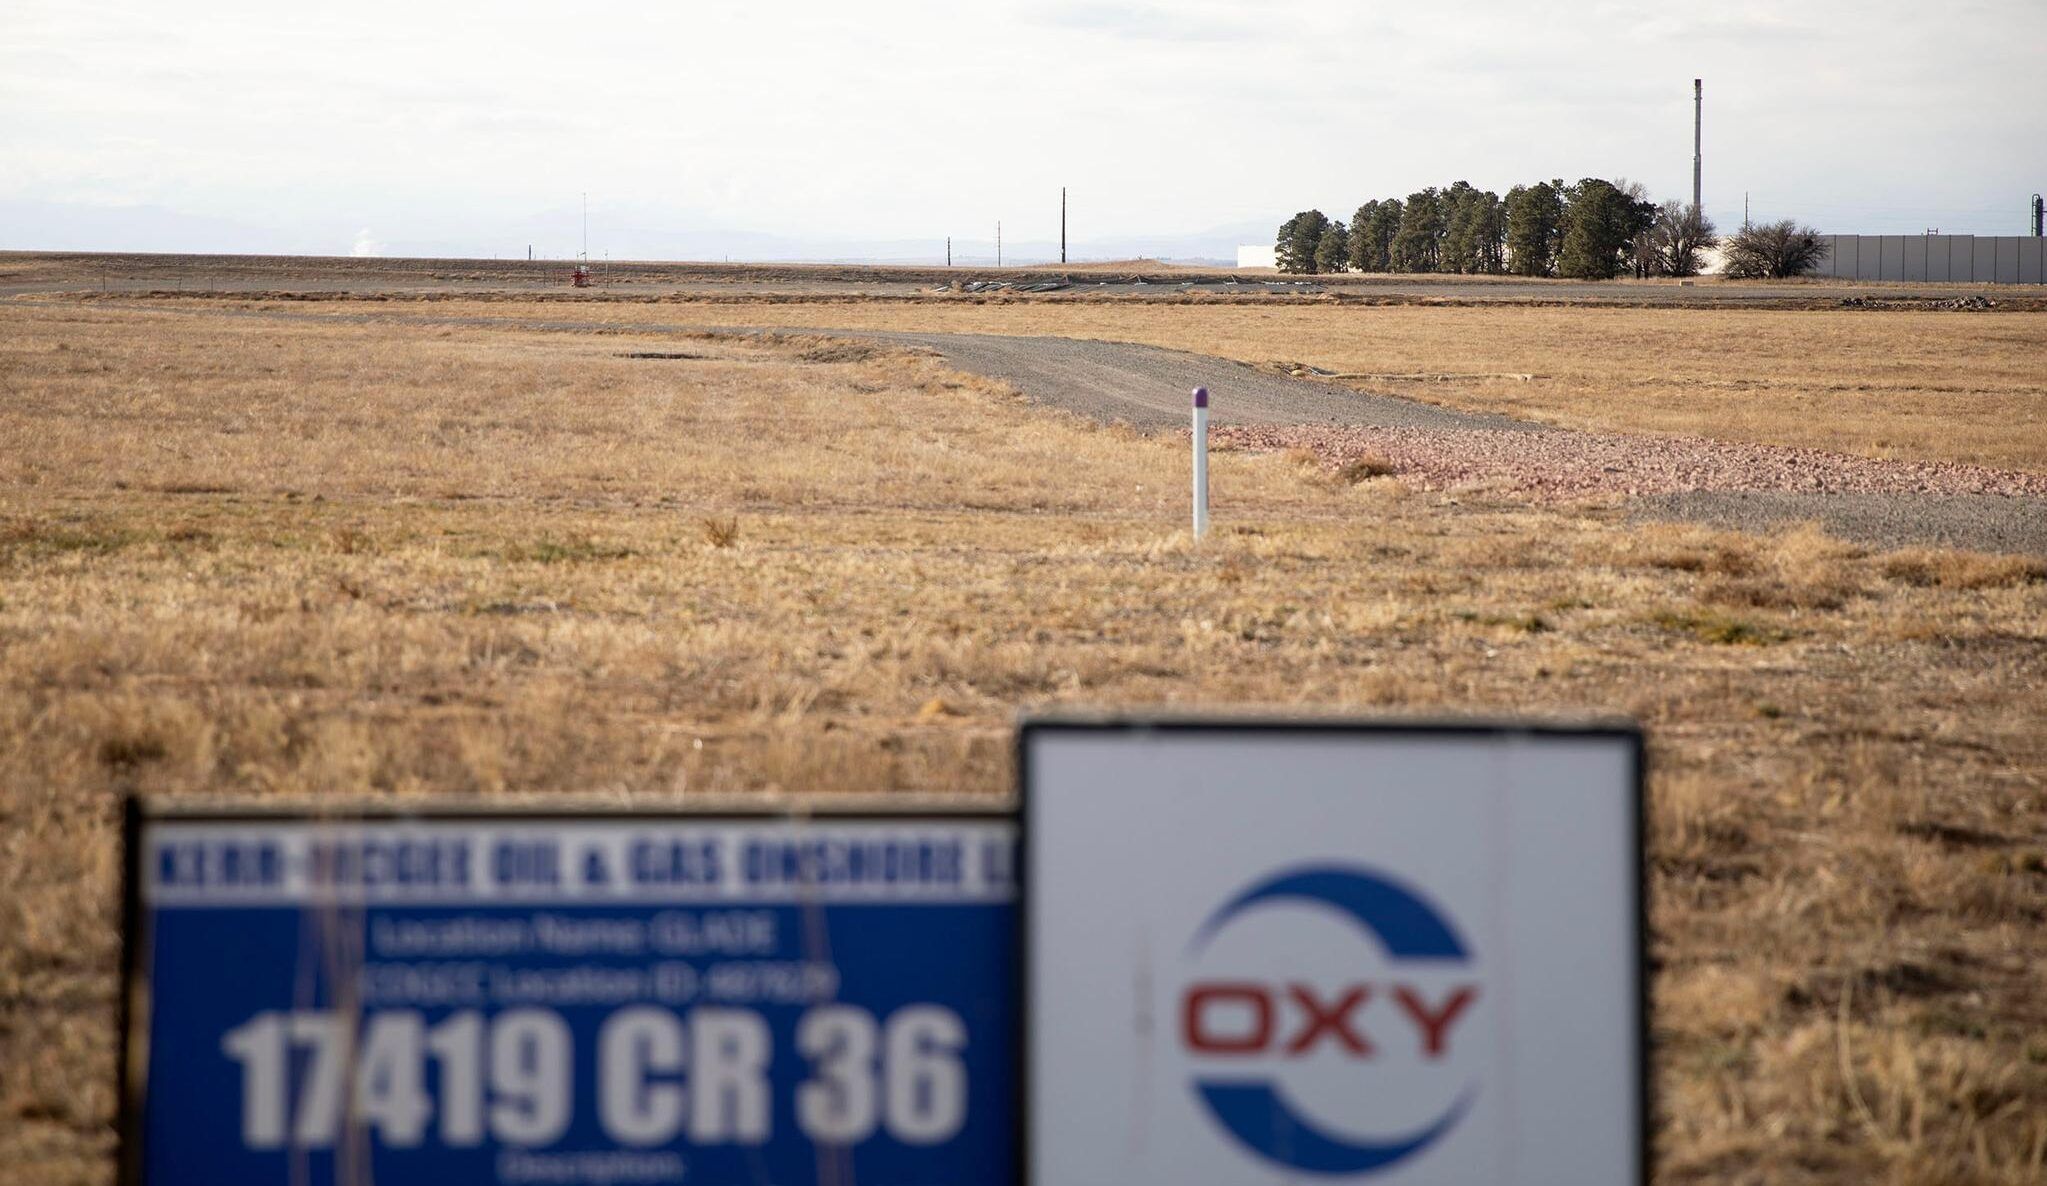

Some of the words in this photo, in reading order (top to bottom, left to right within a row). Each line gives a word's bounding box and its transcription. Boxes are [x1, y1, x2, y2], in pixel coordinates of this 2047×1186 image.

[489, 837, 566, 889] OIL
[578, 844, 613, 889] &
[627, 837, 724, 889] GAS
[1182, 983, 1478, 1059] OXY
[223, 1010, 573, 1147] 17419
[600, 1006, 773, 1147] CR
[796, 1005, 967, 1146] 36
